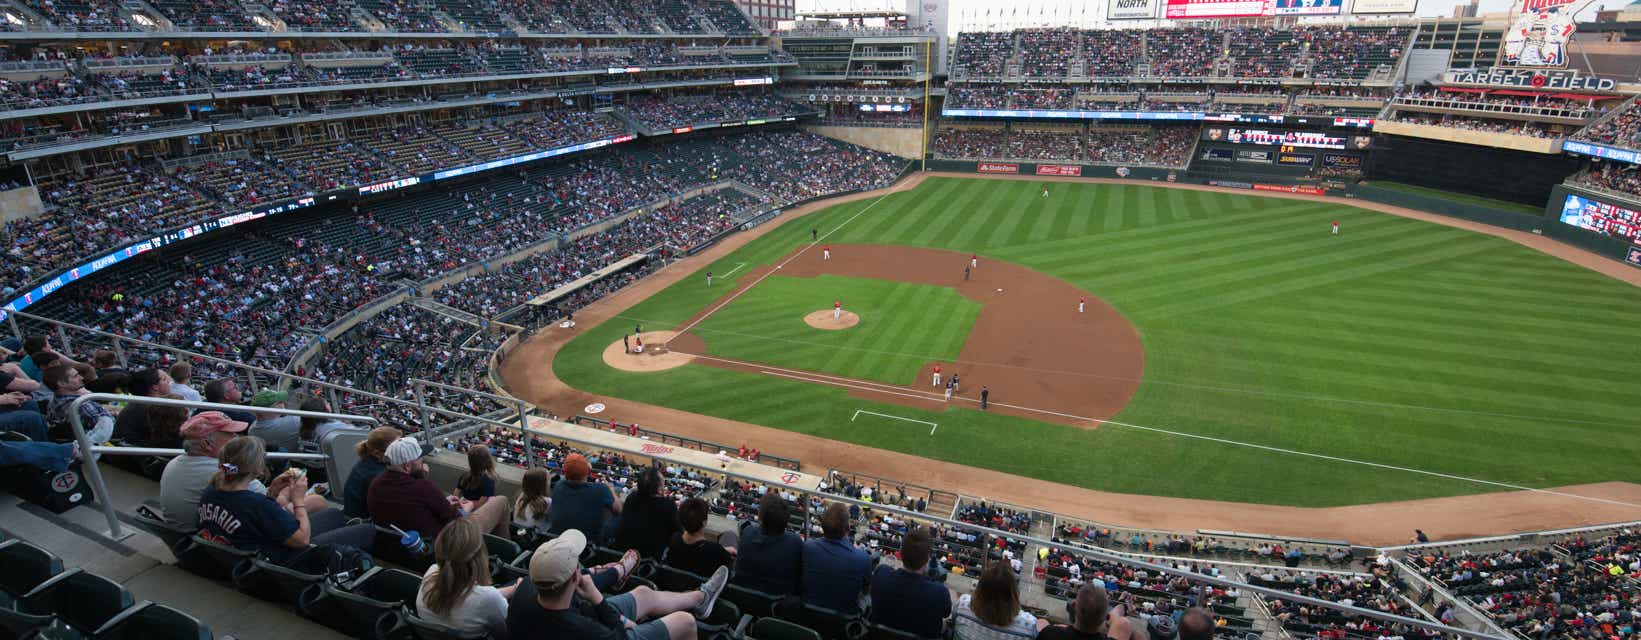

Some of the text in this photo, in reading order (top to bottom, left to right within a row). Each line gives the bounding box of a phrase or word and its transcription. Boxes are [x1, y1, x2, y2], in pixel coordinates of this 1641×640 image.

[1116, 0, 1147, 8] NORTH
[1454, 71, 1614, 90] TARGET FIELD
[641, 443, 675, 454] Twins
